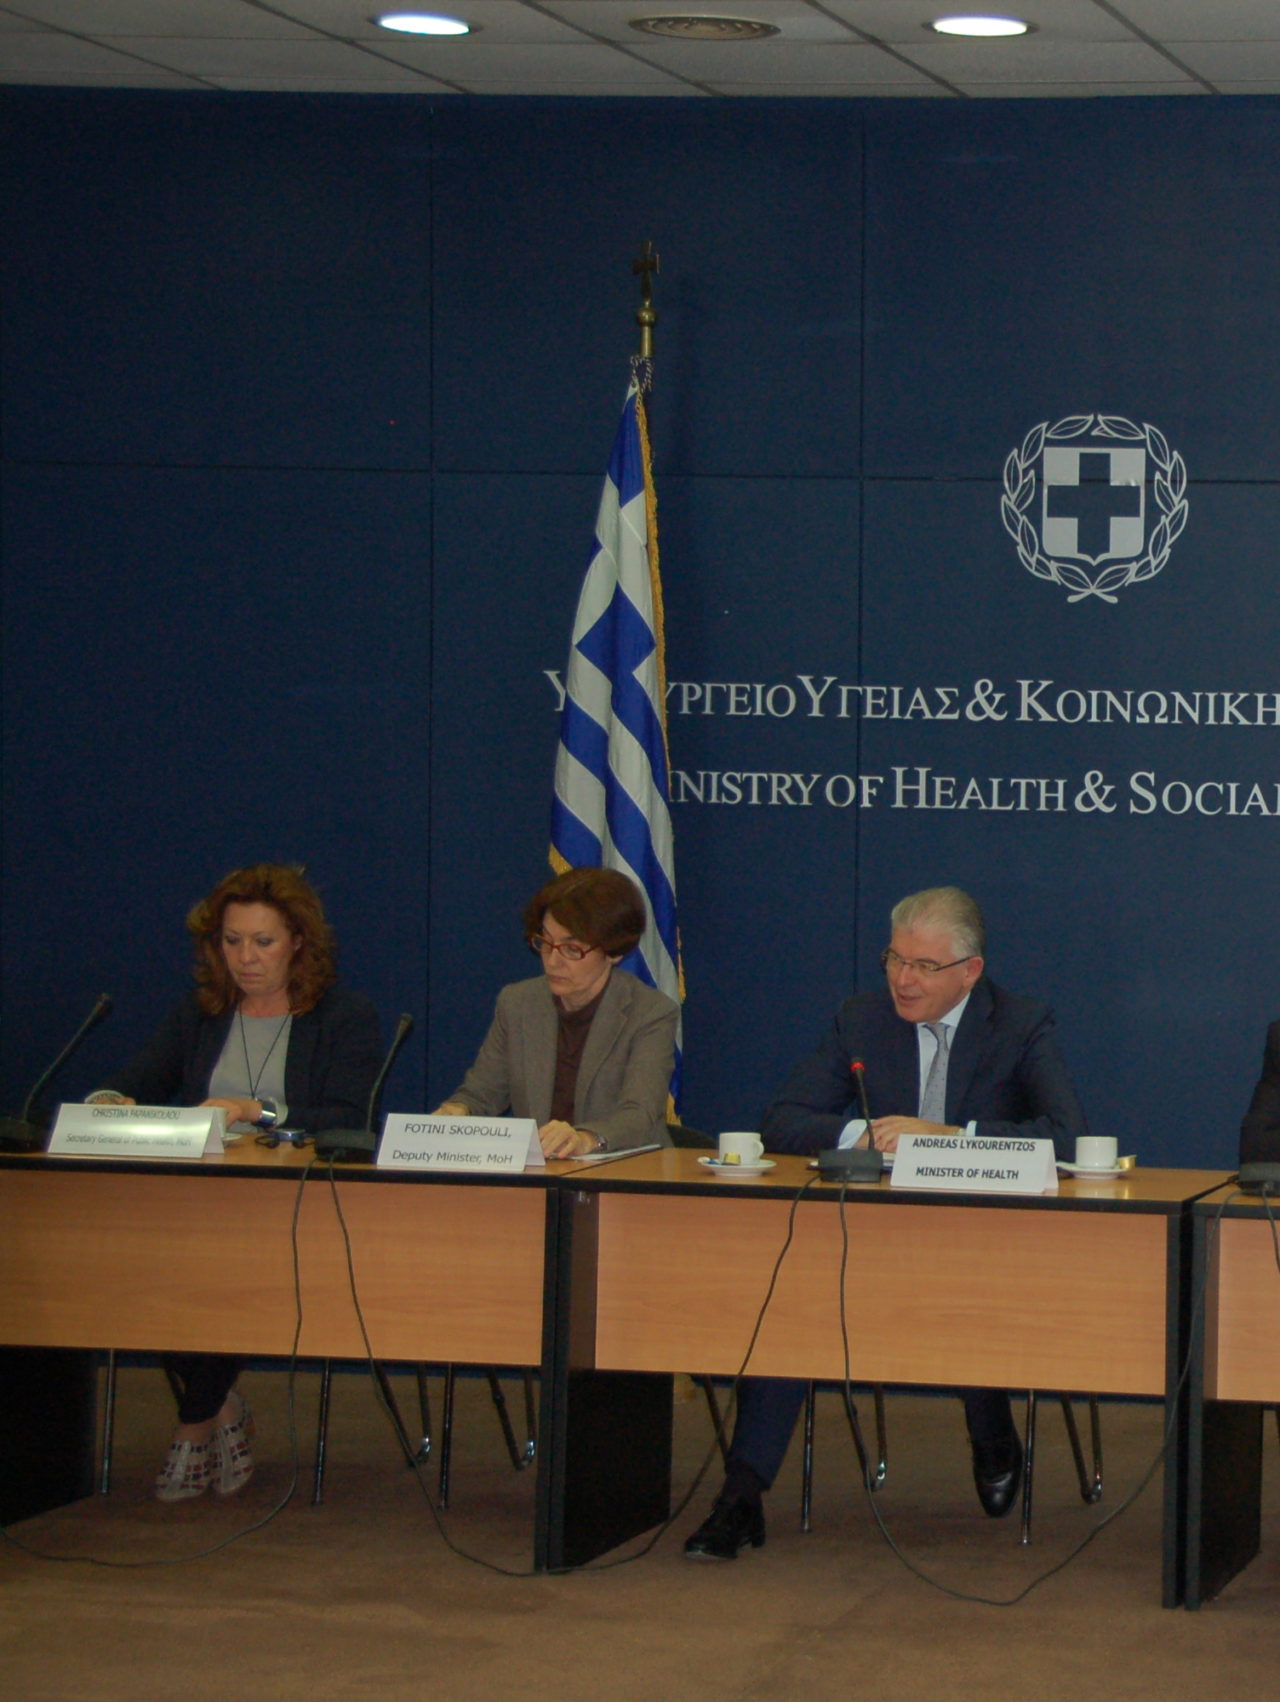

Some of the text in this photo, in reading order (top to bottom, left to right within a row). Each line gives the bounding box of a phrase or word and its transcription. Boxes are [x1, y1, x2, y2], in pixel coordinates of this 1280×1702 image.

[797, 675, 960, 719] ΥΓΕΙΑΣ
[965, 679, 1008, 721] &
[825, 774, 884, 808] OF
[890, 766, 1068, 812] HEALTH
[1074, 770, 1118, 813] &
[404, 1123, 446, 1135] FOTINI
[912, 1138, 1036, 1151] ANDREAS LYKOURENTZOS
[392, 1149, 433, 1162] Deputy
[487, 1154, 513, 1164] MoH
[915, 1167, 1019, 1180] MINISTER OF HEALTH
